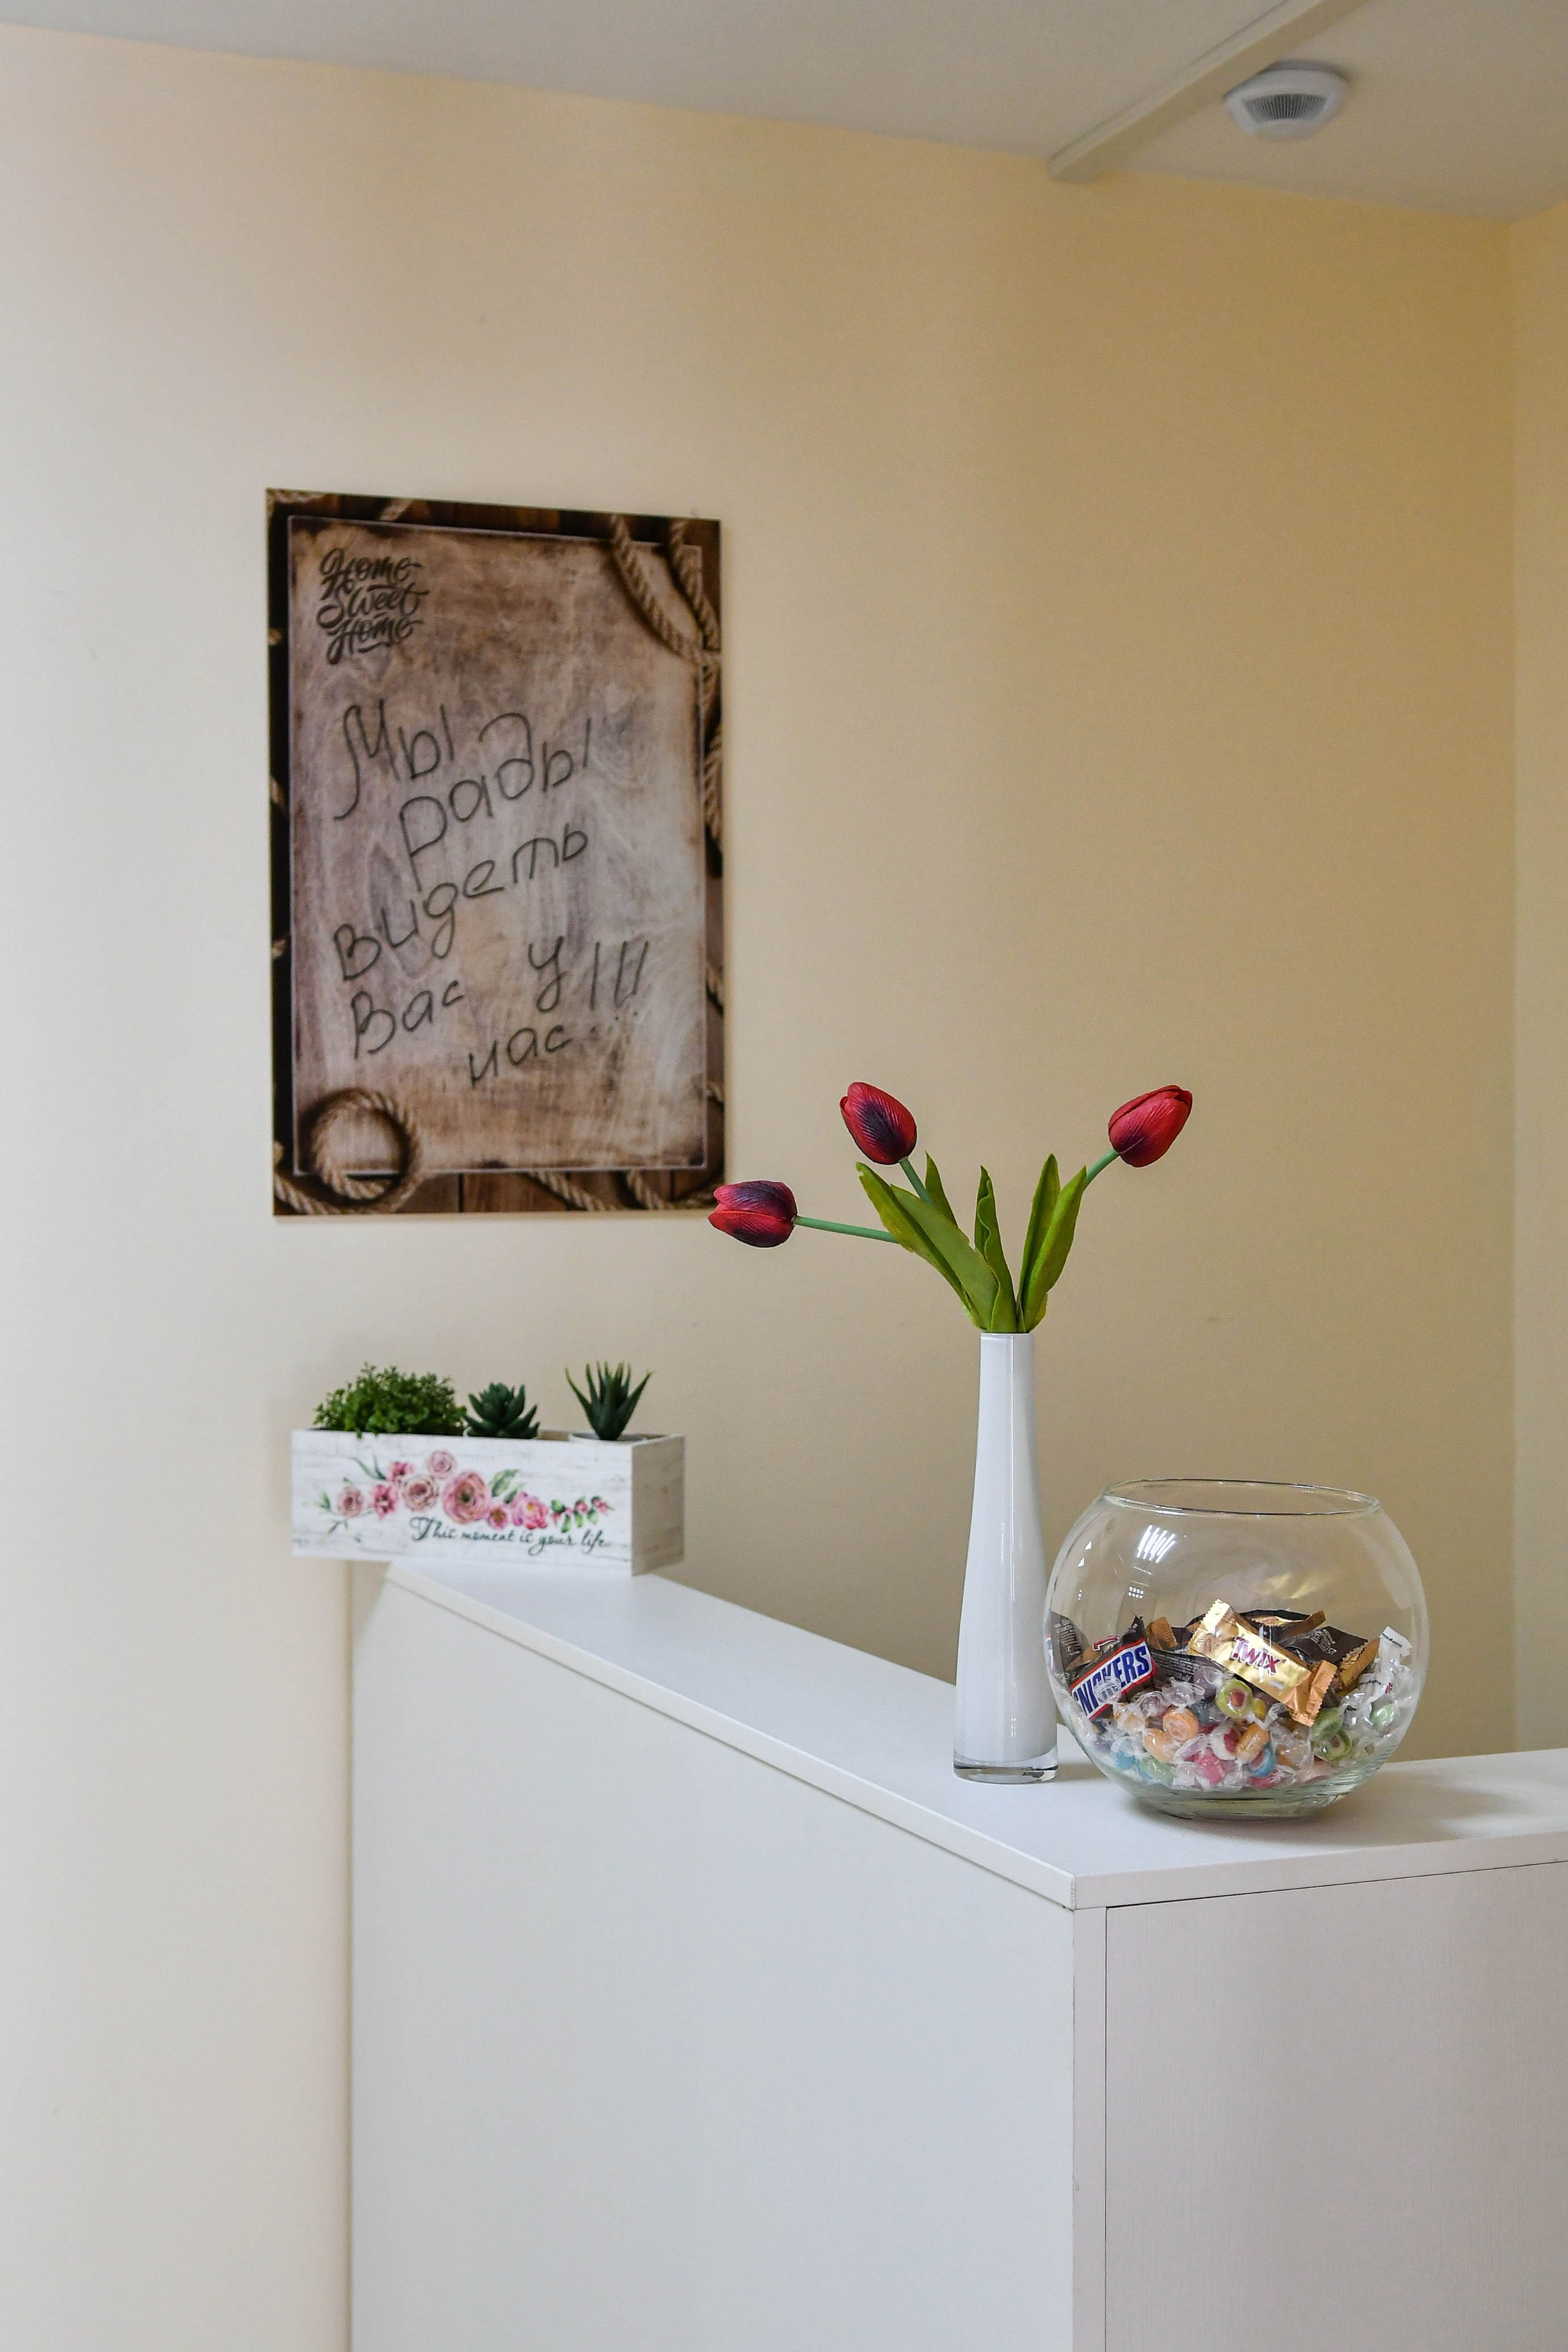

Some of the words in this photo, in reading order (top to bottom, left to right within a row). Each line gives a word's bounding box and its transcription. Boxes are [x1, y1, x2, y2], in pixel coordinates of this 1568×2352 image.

[326, 614, 423, 665] Home
[333, 698, 455, 821] Мы
[409, 1516, 457, 1542] This
[461, 1529, 514, 1542] moment
[519, 1531, 534, 1544] is
[528, 1531, 575, 1556] your
